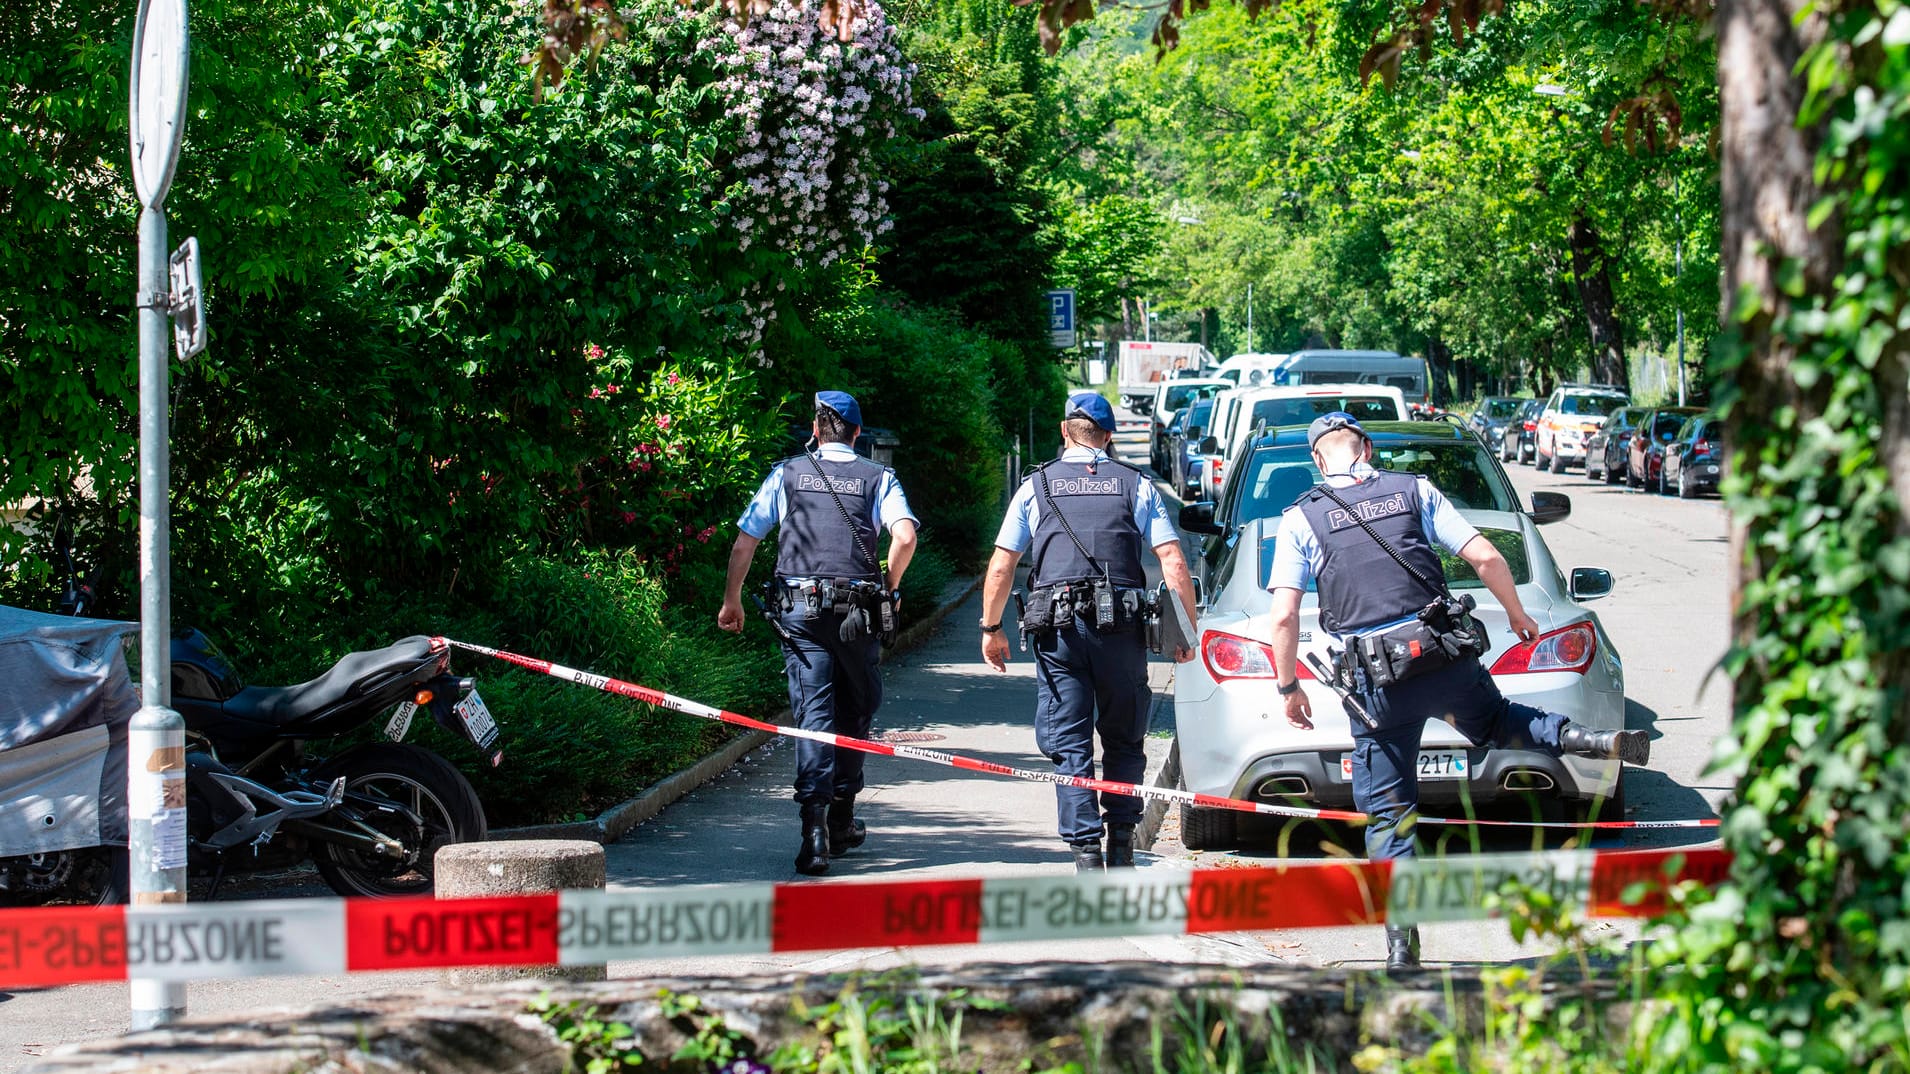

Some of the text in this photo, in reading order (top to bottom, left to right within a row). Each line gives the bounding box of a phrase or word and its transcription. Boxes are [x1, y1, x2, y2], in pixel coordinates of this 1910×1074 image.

[1052, 296, 1065, 315] P
[1052, 477, 1118, 495] Polizei
[1328, 493, 1406, 529] Polizei
[1420, 755, 1453, 774] 217
